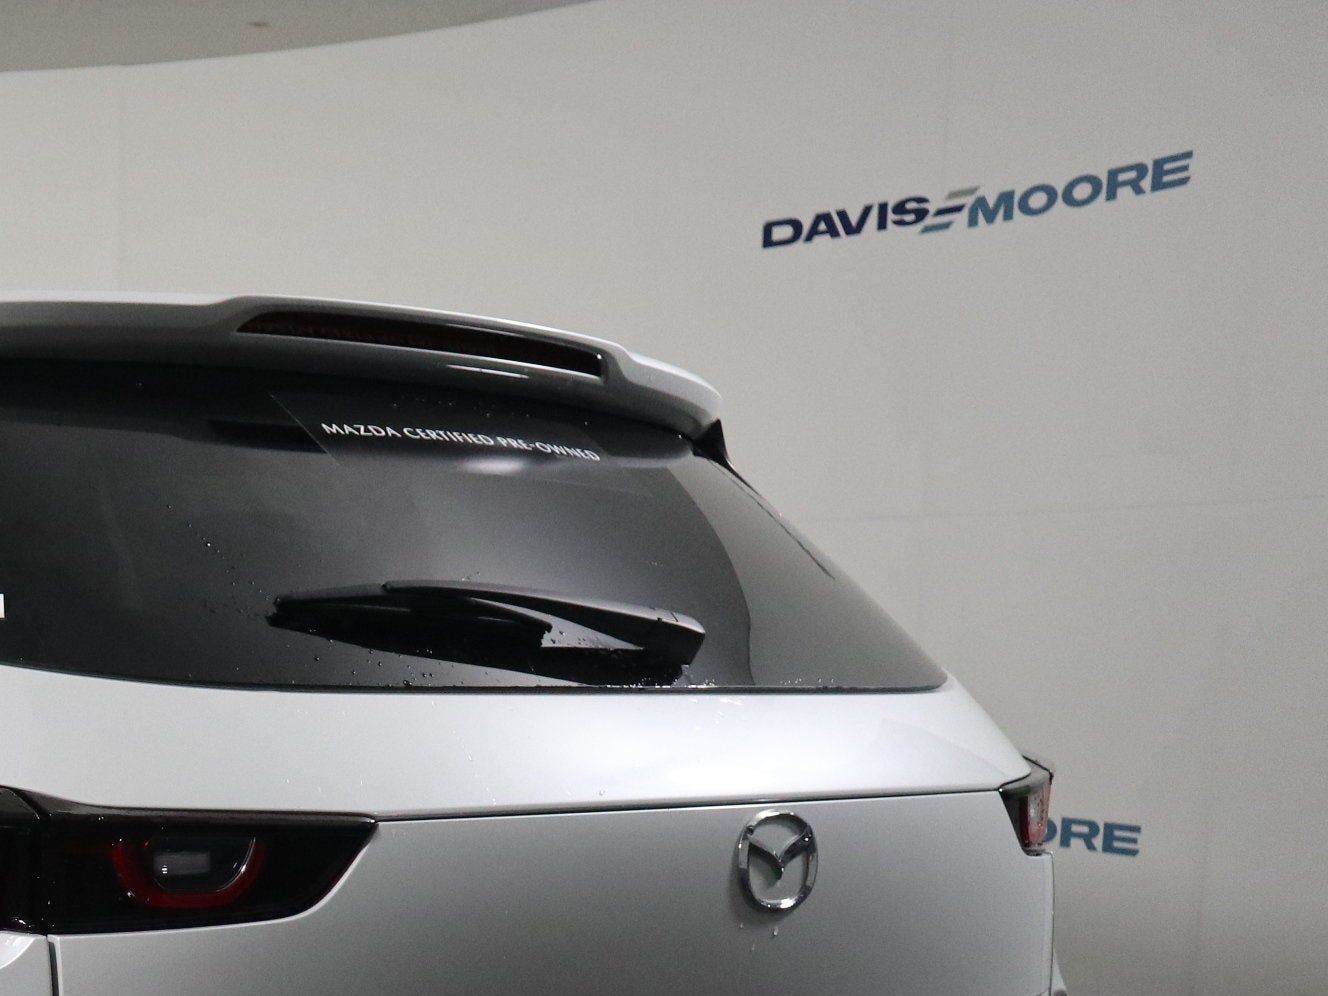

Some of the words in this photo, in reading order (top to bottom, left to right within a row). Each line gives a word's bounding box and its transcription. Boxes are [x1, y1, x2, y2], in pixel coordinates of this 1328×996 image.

[762, 196, 931, 249] DAVIS
[967, 149, 1193, 228] MOORE
[321, 422, 402, 438] MAZDA
[402, 427, 495, 447] CERTIFIED
[496, 435, 601, 462] PRE-OWNED
